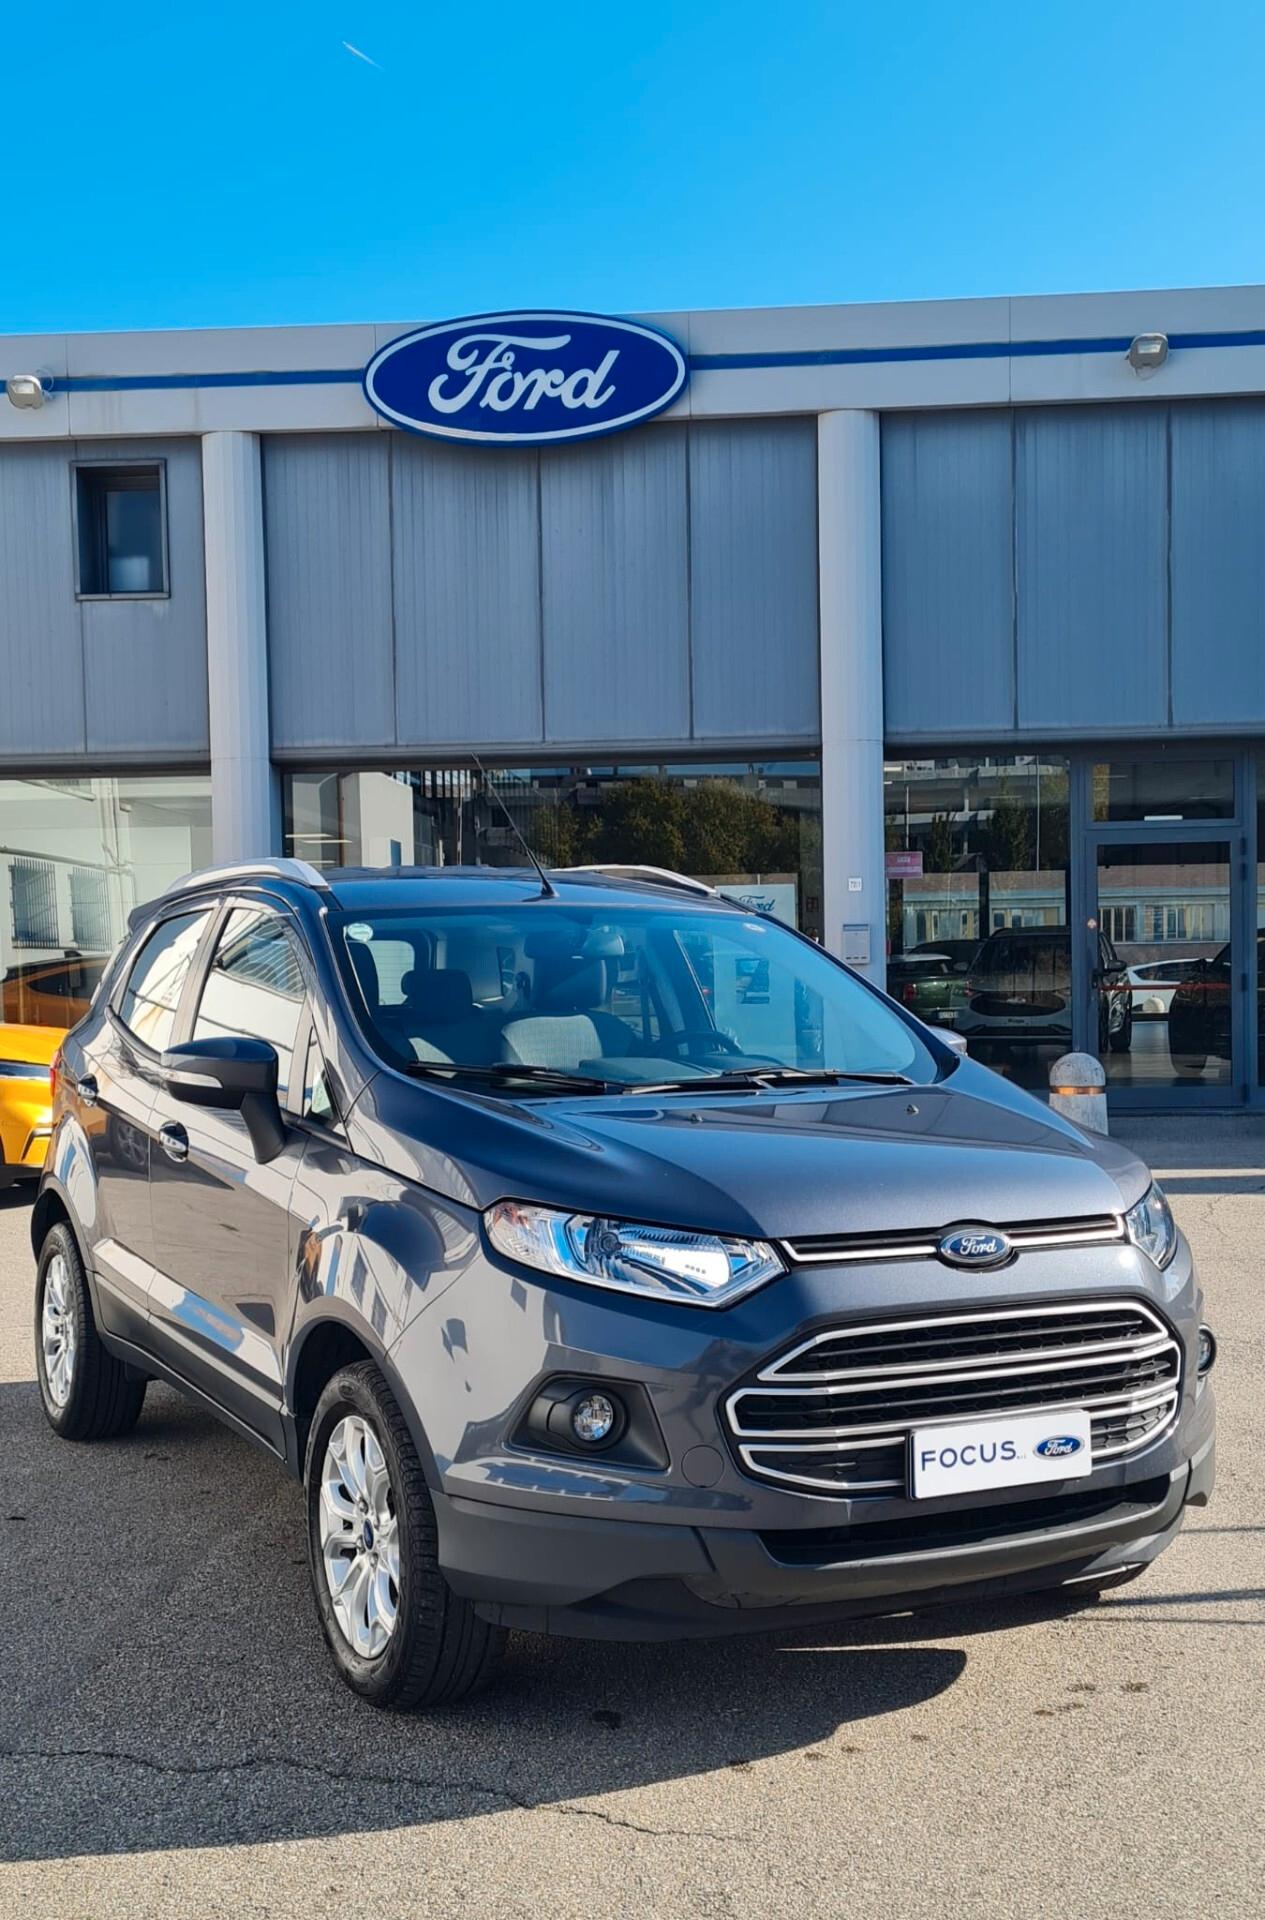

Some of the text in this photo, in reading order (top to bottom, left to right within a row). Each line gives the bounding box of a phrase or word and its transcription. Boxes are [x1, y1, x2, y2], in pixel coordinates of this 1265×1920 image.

[428, 333, 620, 413] Ford
[960, 1236, 997, 1255] Ford
[921, 1439, 1073, 1471] FOCUS Ford
